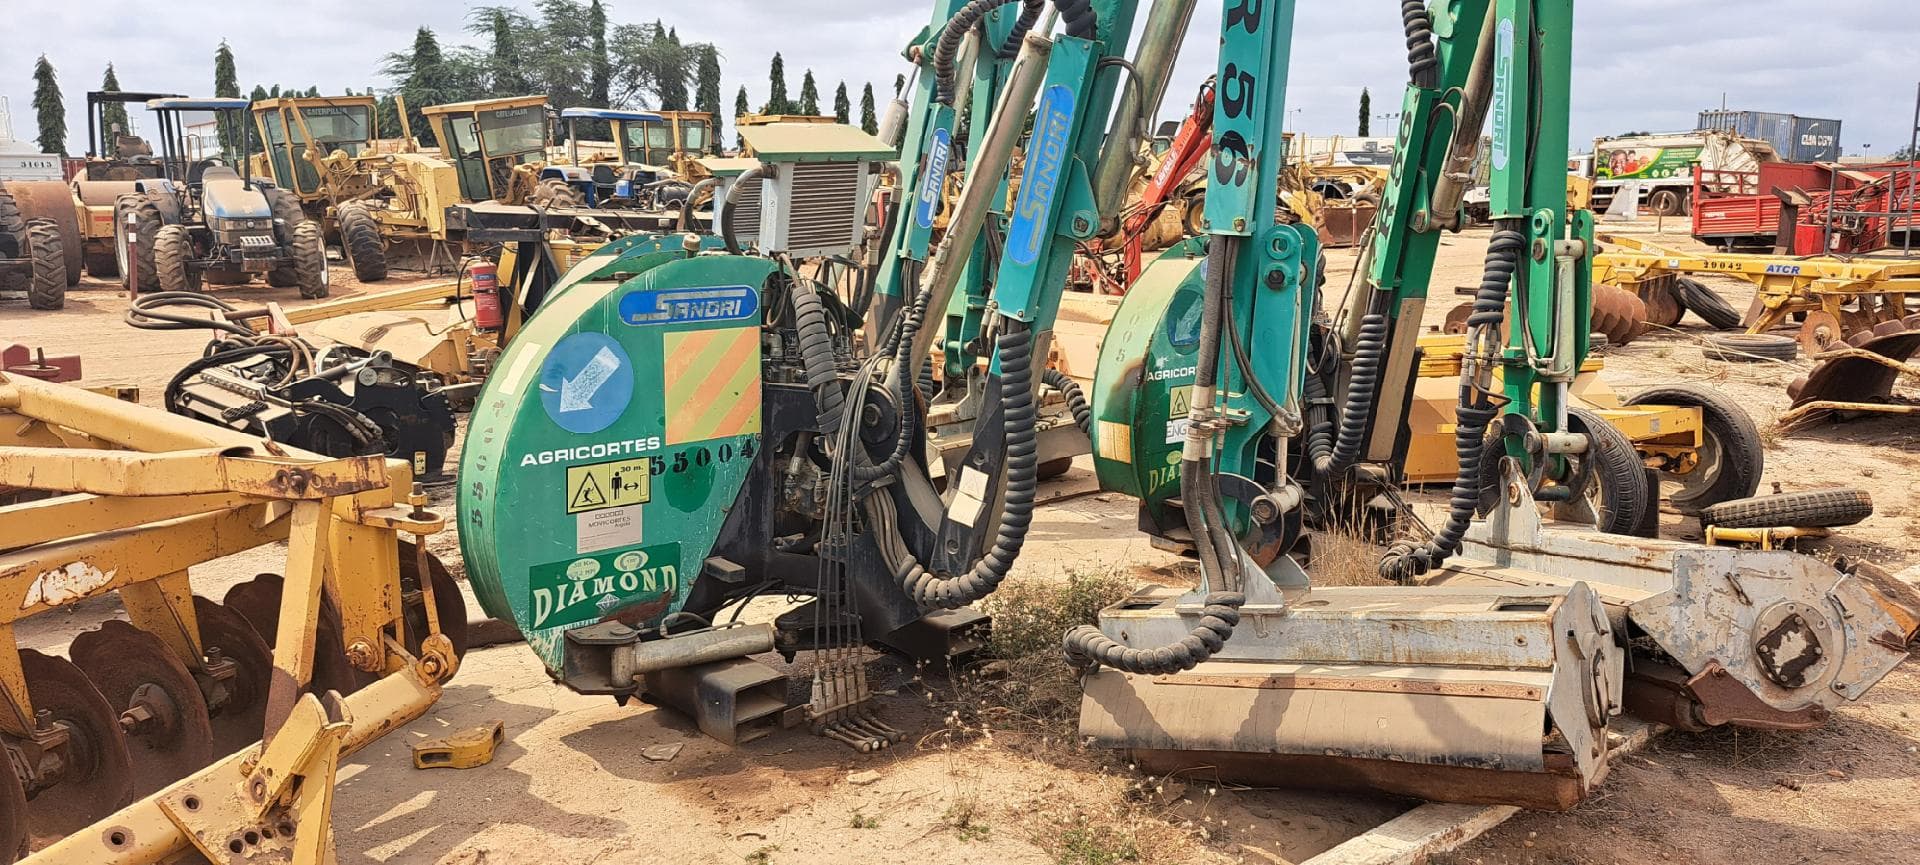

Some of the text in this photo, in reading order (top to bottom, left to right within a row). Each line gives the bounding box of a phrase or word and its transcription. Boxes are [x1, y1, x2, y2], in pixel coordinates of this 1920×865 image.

[922, 136, 949, 221] SANDRI
[1021, 99, 1069, 251] SANDRI
[1766, 264, 1801, 275] ATCR
[631, 289, 747, 321] SANDRI
[1147, 366, 1199, 381] AGRICOR
[520, 436, 661, 467] AGRICORTES
[650, 438, 754, 476] 55004
[532, 565, 678, 629] DIAMOND
